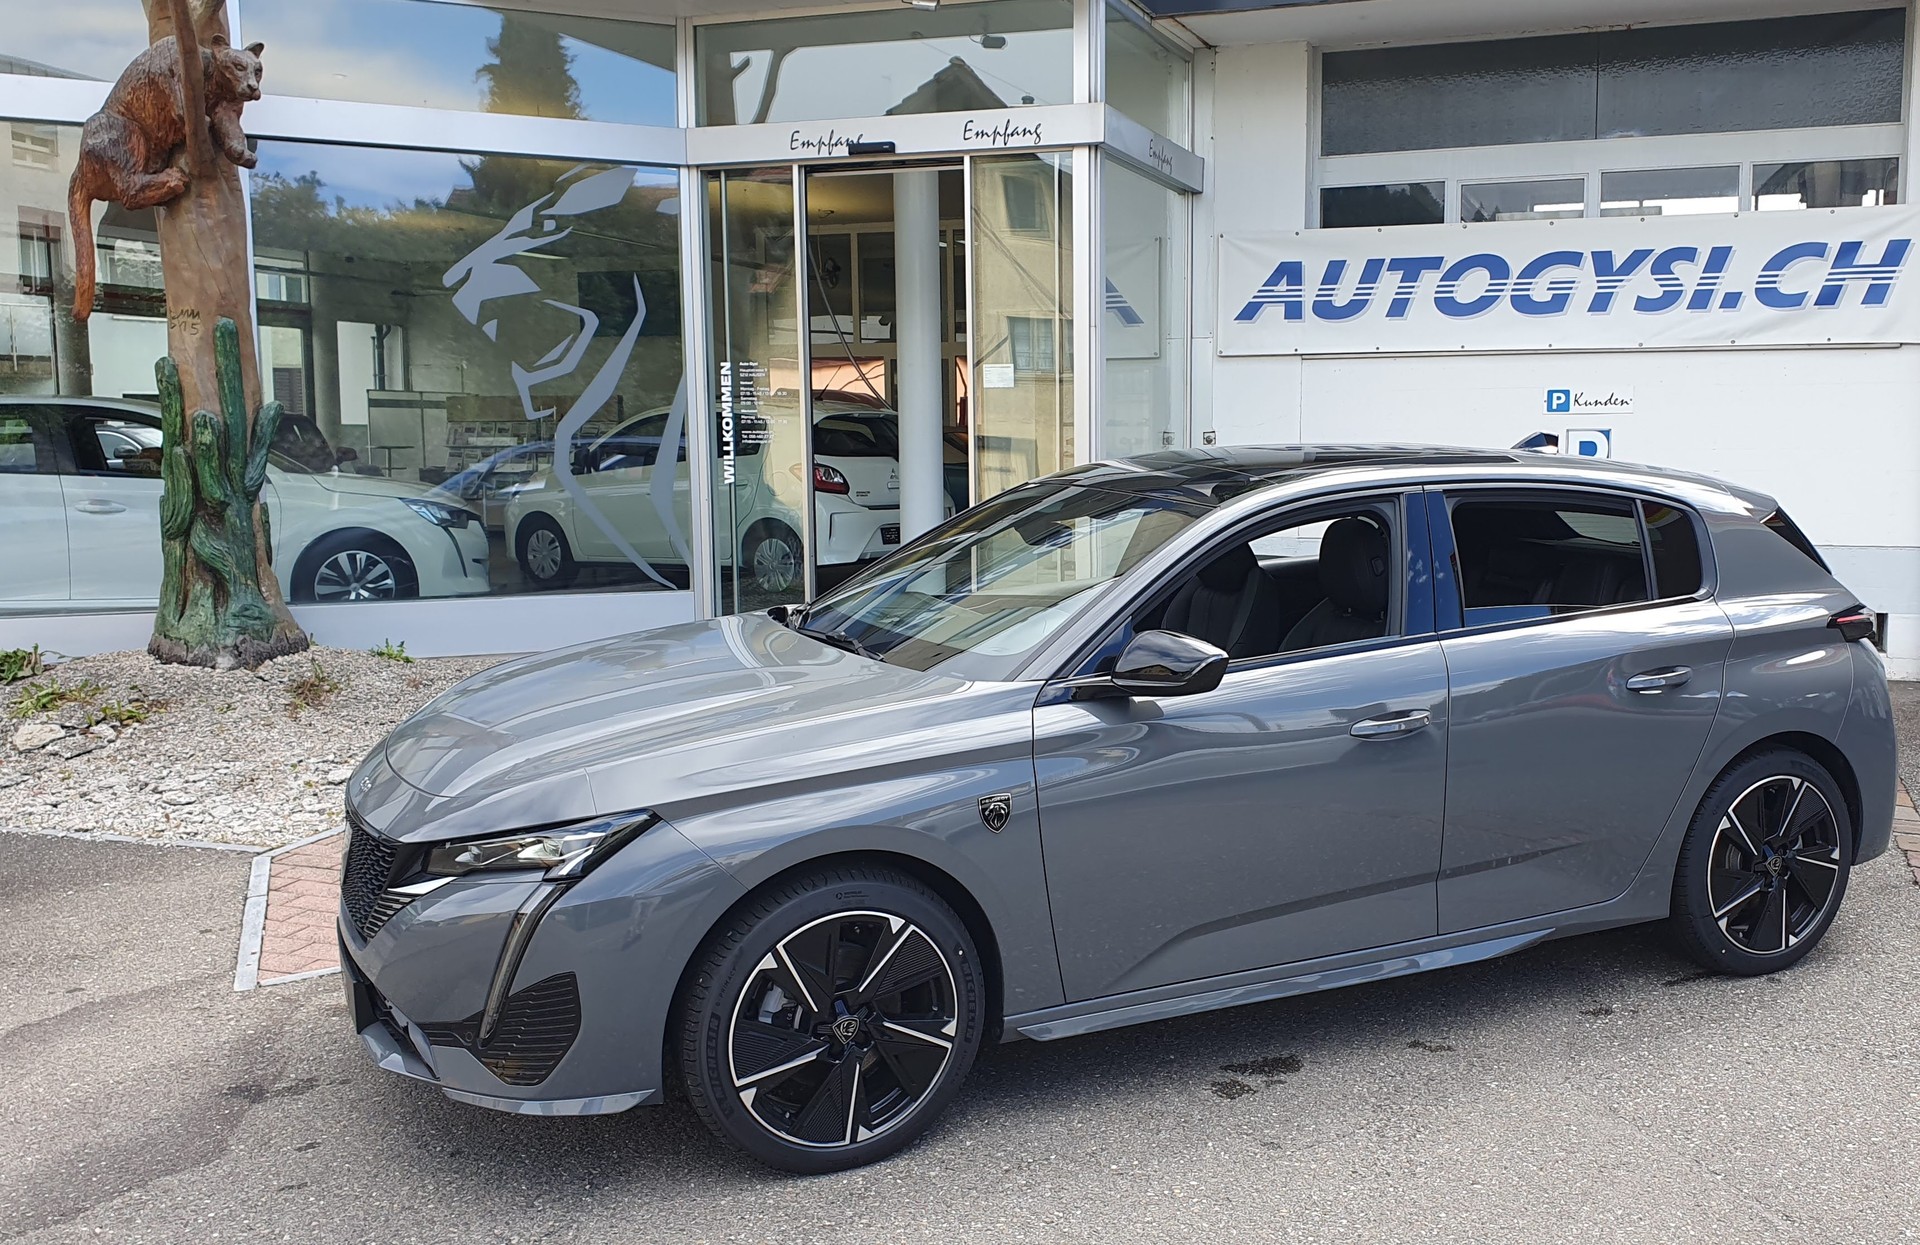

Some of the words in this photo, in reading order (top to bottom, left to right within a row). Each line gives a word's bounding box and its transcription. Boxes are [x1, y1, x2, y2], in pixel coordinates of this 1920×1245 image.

[963, 118, 1042, 146] Empfang
[1233, 238, 1914, 323] AUTOGYSI.CH
[720, 361, 735, 484] WILLKOMMEN
[1573, 391, 1630, 407] Kunden
